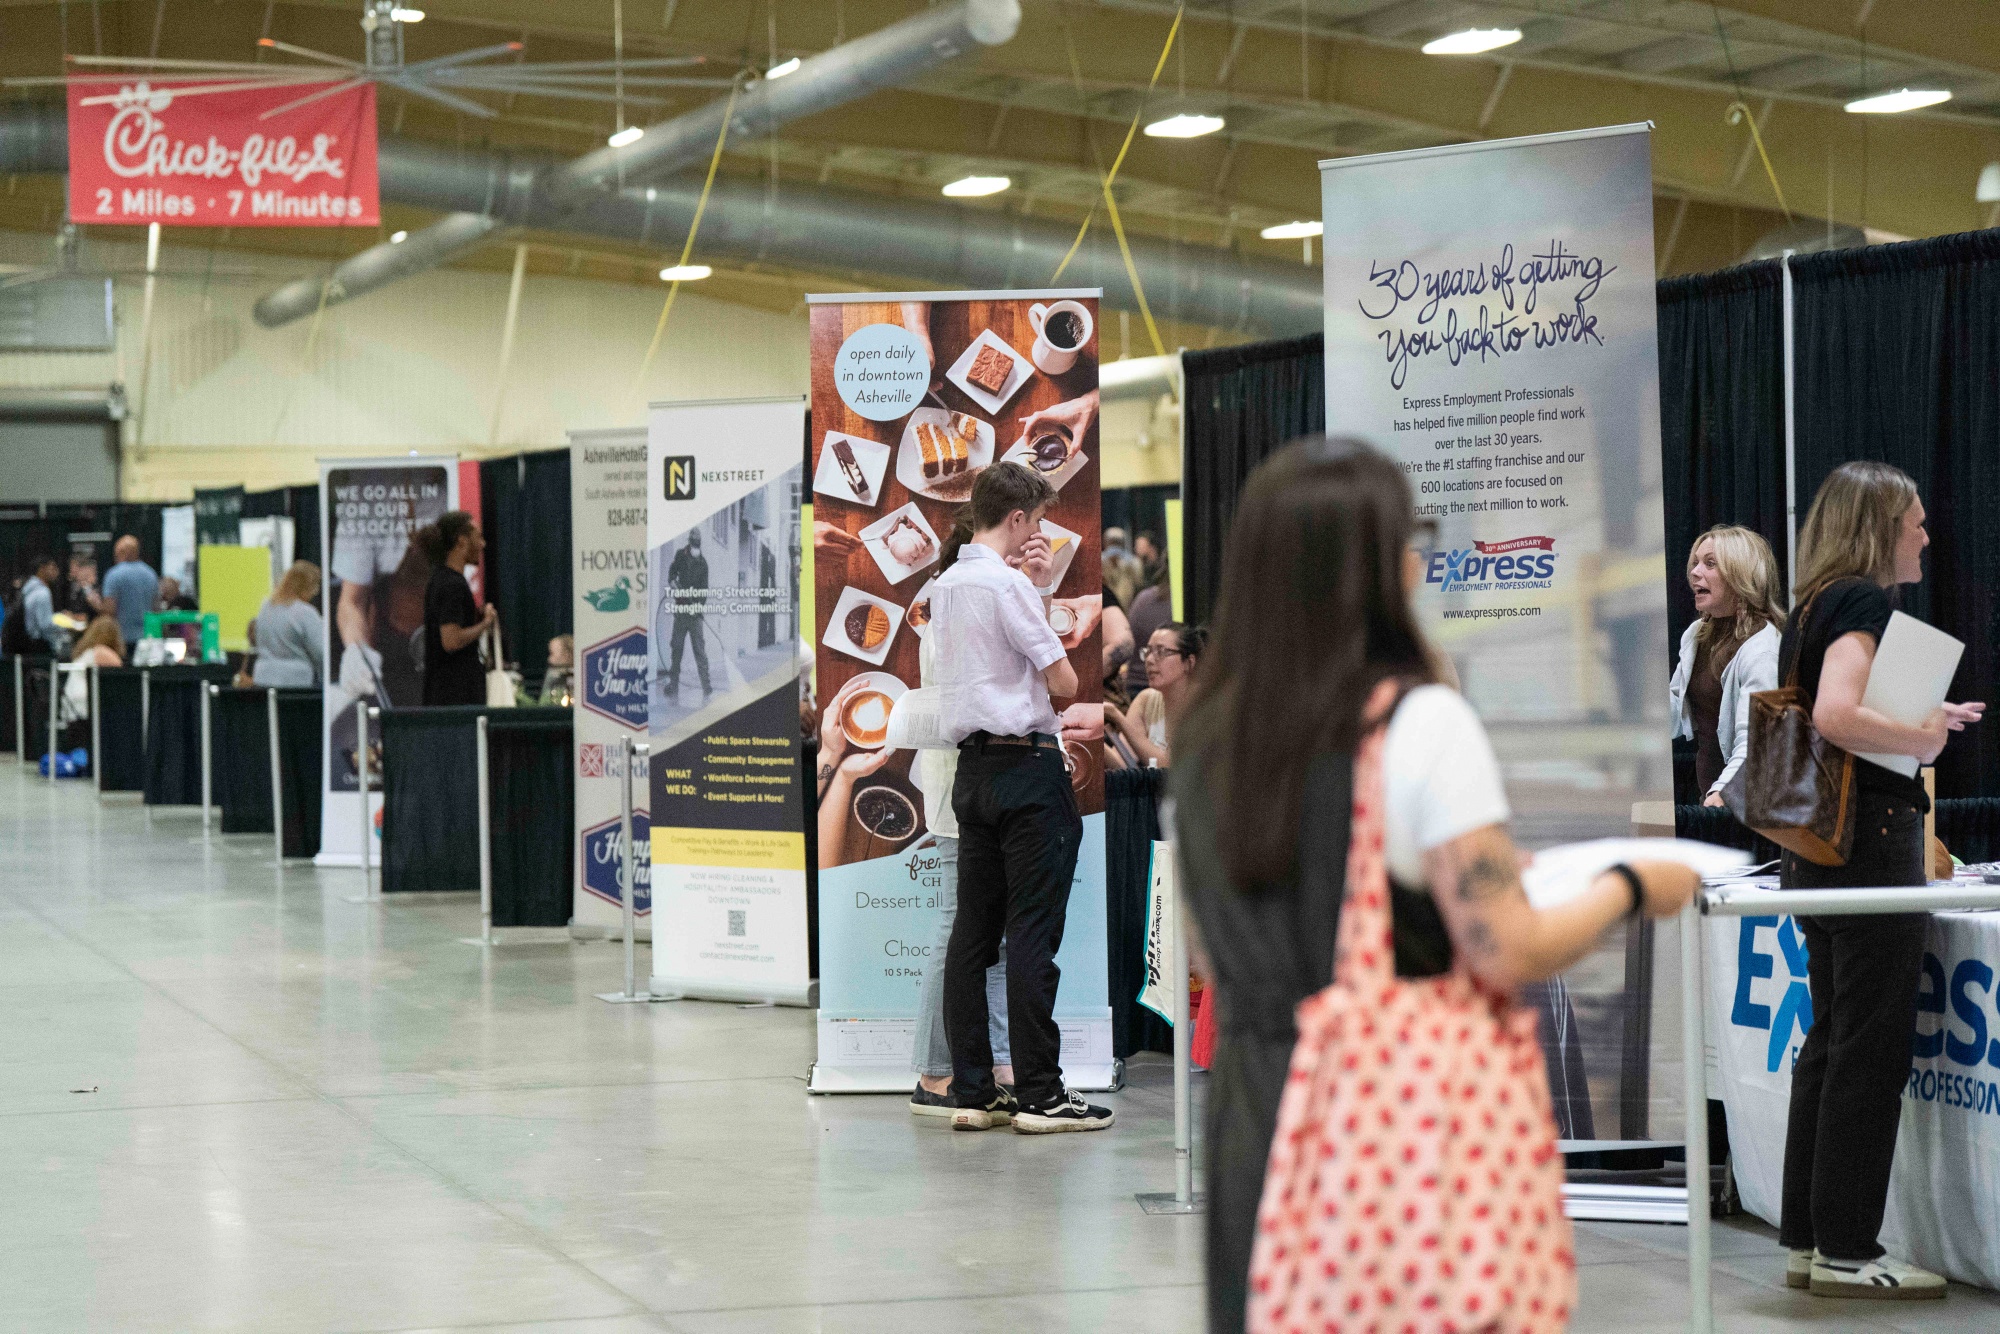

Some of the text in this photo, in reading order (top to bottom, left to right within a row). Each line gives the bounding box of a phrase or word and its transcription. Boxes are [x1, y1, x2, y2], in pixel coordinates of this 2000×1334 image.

[104, 104, 345, 187] Chick-fil-A
[96, 188, 363, 217] 2 Miles 7 Minutes
[1358, 239, 1618, 324] 30 years of getting
[1441, 304, 1500, 367] back
[1492, 311, 1529, 352] to
[850, 345, 916, 364] open daily
[842, 369, 924, 382] in downtown
[855, 390, 912, 403] Asheville
[1403, 385, 1575, 411] Express Employment Professionals
[1394, 406, 1585, 432] has helped five million people find work
[1435, 432, 1542, 450] over the last 30 years.
[1425, 459, 1441, 472] the
[1442, 458, 1455, 471] #1
[1456, 456, 1492, 471] staffing
[1495, 453, 1543, 468] franchise
[1545, 451, 1565, 464] and
[1567, 452, 1585, 463] our
[701, 470, 765, 482] NEXSTREET
[1421, 473, 1563, 494] 600 locations are focused on
[335, 484, 439, 500] WE GO ALL IN
[335, 502, 409, 518] FOR OUR
[1414, 494, 1569, 517] putting the next million to work.
[1497, 539, 1542, 551] ANNIVERSARY
[664, 586, 723, 599] Transforming
[1449, 580, 1552, 592] EMPLOYMENT PROFESSIONALS
[664, 601, 793, 615] Strengthening Communities.
[1443, 605, 1541, 619] www.expresspros.com
[707, 735, 728, 746] Public
[729, 736, 751, 747] Space
[707, 754, 747, 766] Community
[666, 769, 692, 780] WHAT
[707, 773, 792, 785] Workforce Development
[666, 784, 698, 796] WE DO:
[707, 791, 727, 801] Event
[728, 792, 757, 803] Support
[757, 793, 763, 803] &
[855, 891, 943, 909] Dessert all
[884, 939, 931, 957] Choc
[884, 968, 923, 977] 10 S Pack
[1900, 1067, 2000, 1116] ROFESSION
